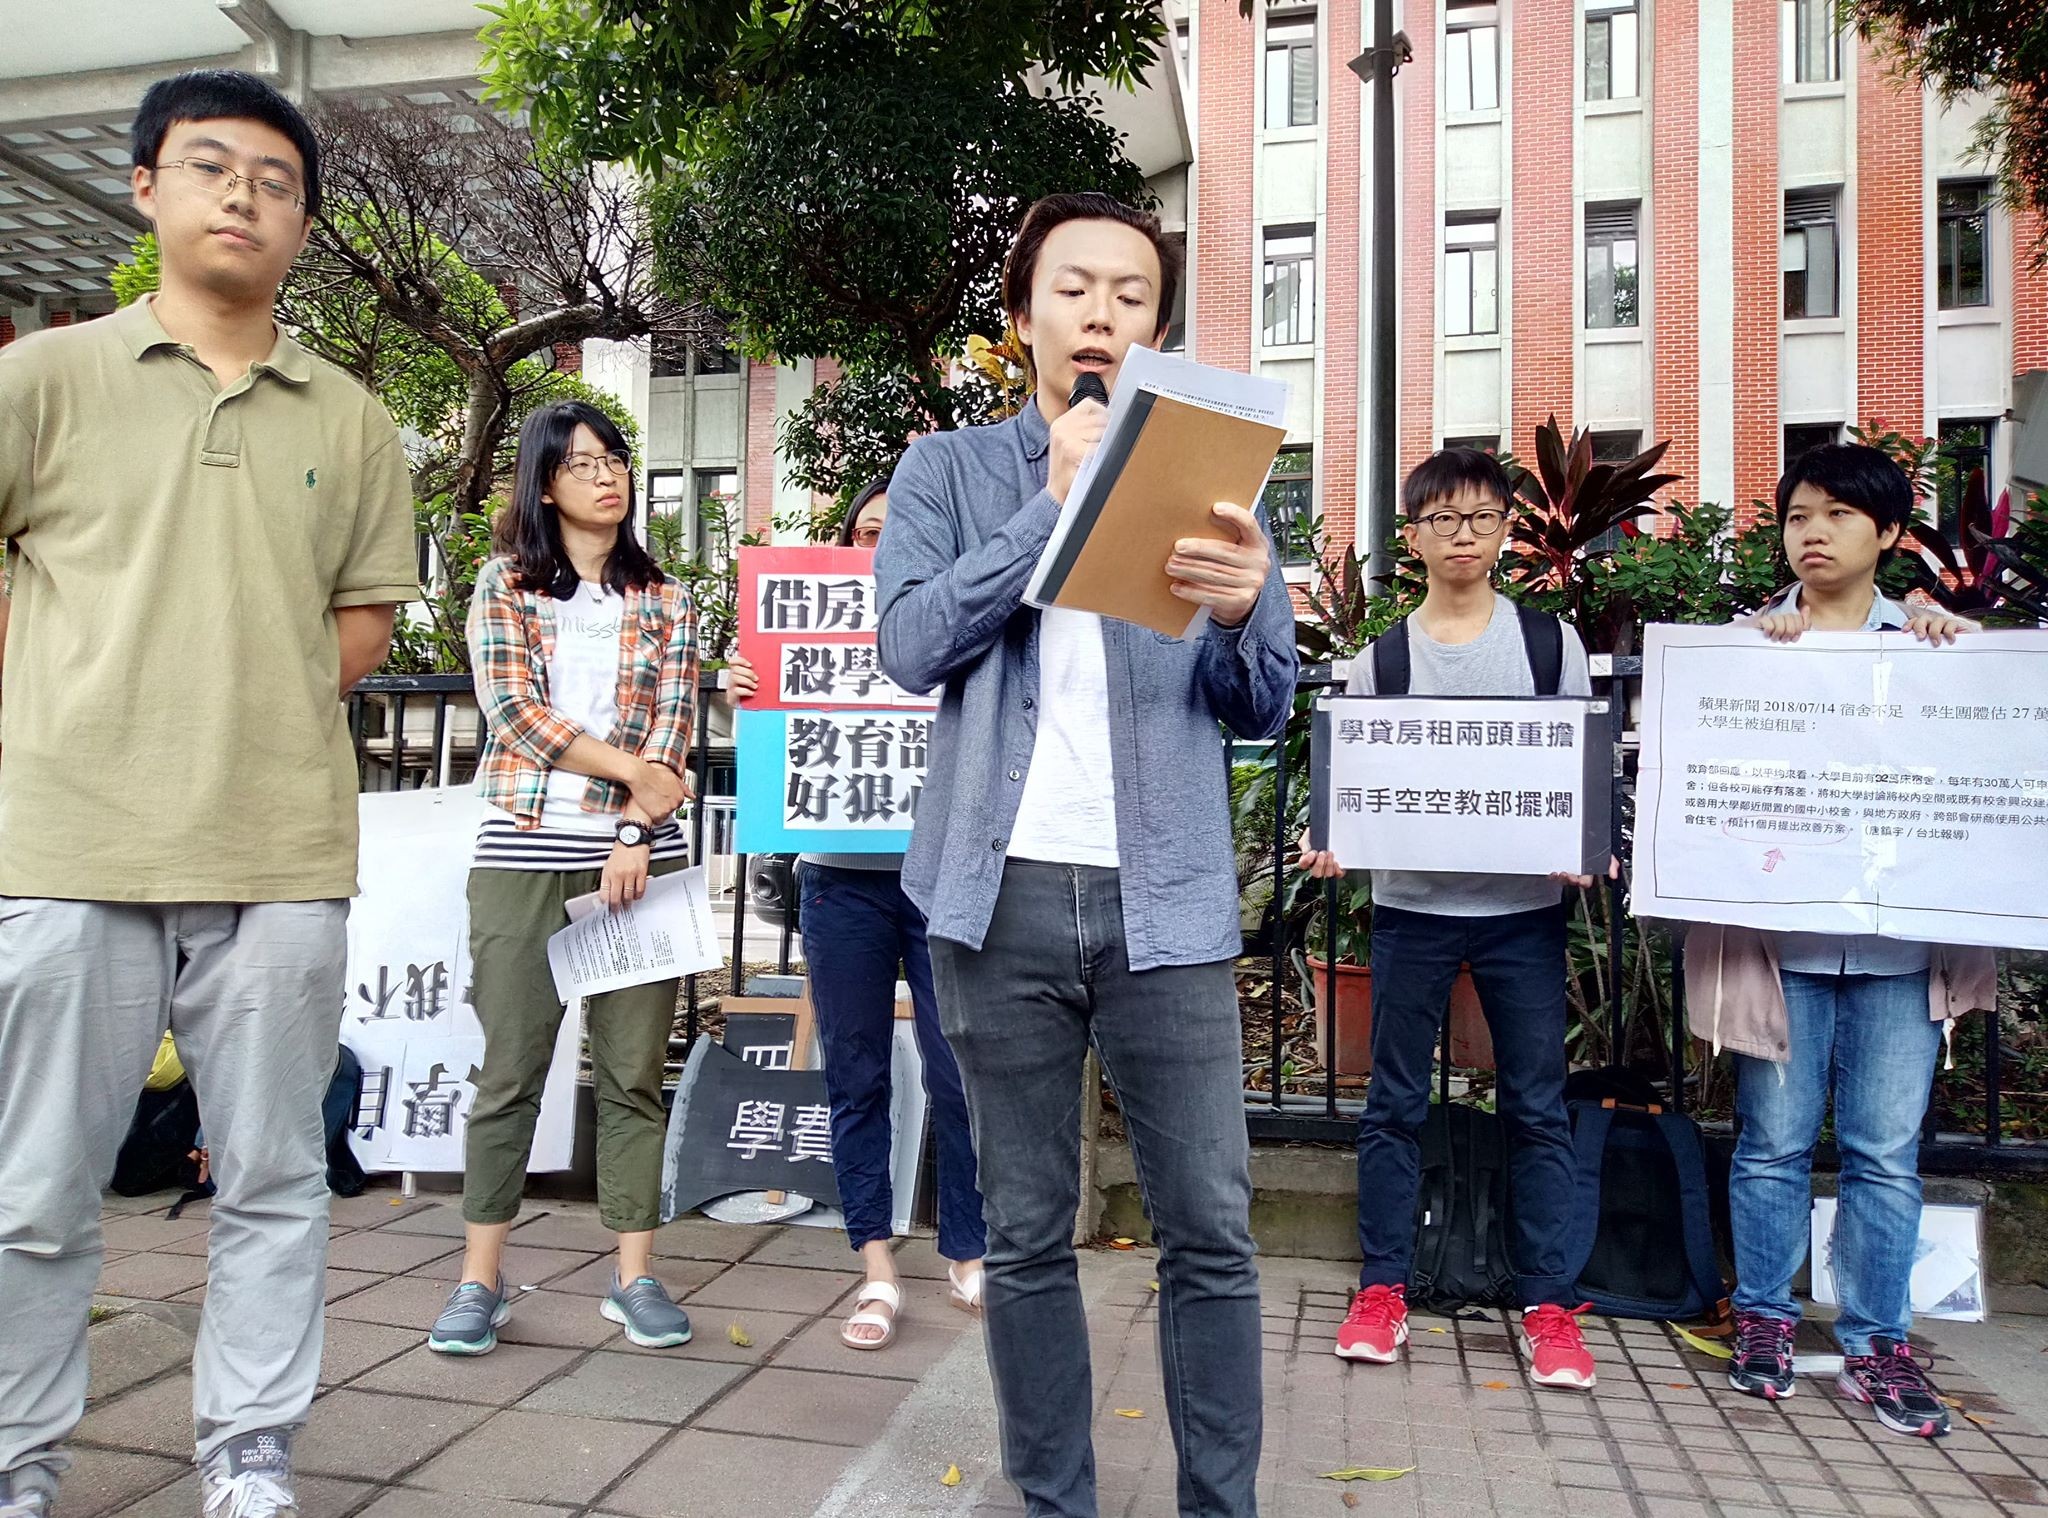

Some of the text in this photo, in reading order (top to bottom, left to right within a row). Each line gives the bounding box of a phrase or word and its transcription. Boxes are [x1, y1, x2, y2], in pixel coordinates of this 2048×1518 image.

[761, 579, 879, 630] 借房
[1699, 696, 1760, 713] 蘋果新聞
[1764, 700, 1835, 714] 2018/07/14
[1840, 703, 1904, 718] 宿舍不足
[1921, 704, 2007, 720] 學生團體估
[2012, 707, 2029, 719] 27
[1337, 718, 1575, 748] 學貸房租兩頭重擔
[1336, 787, 1574, 818] 兩手空空教部擺爛
[241, 1455, 264, 1463] MADE
